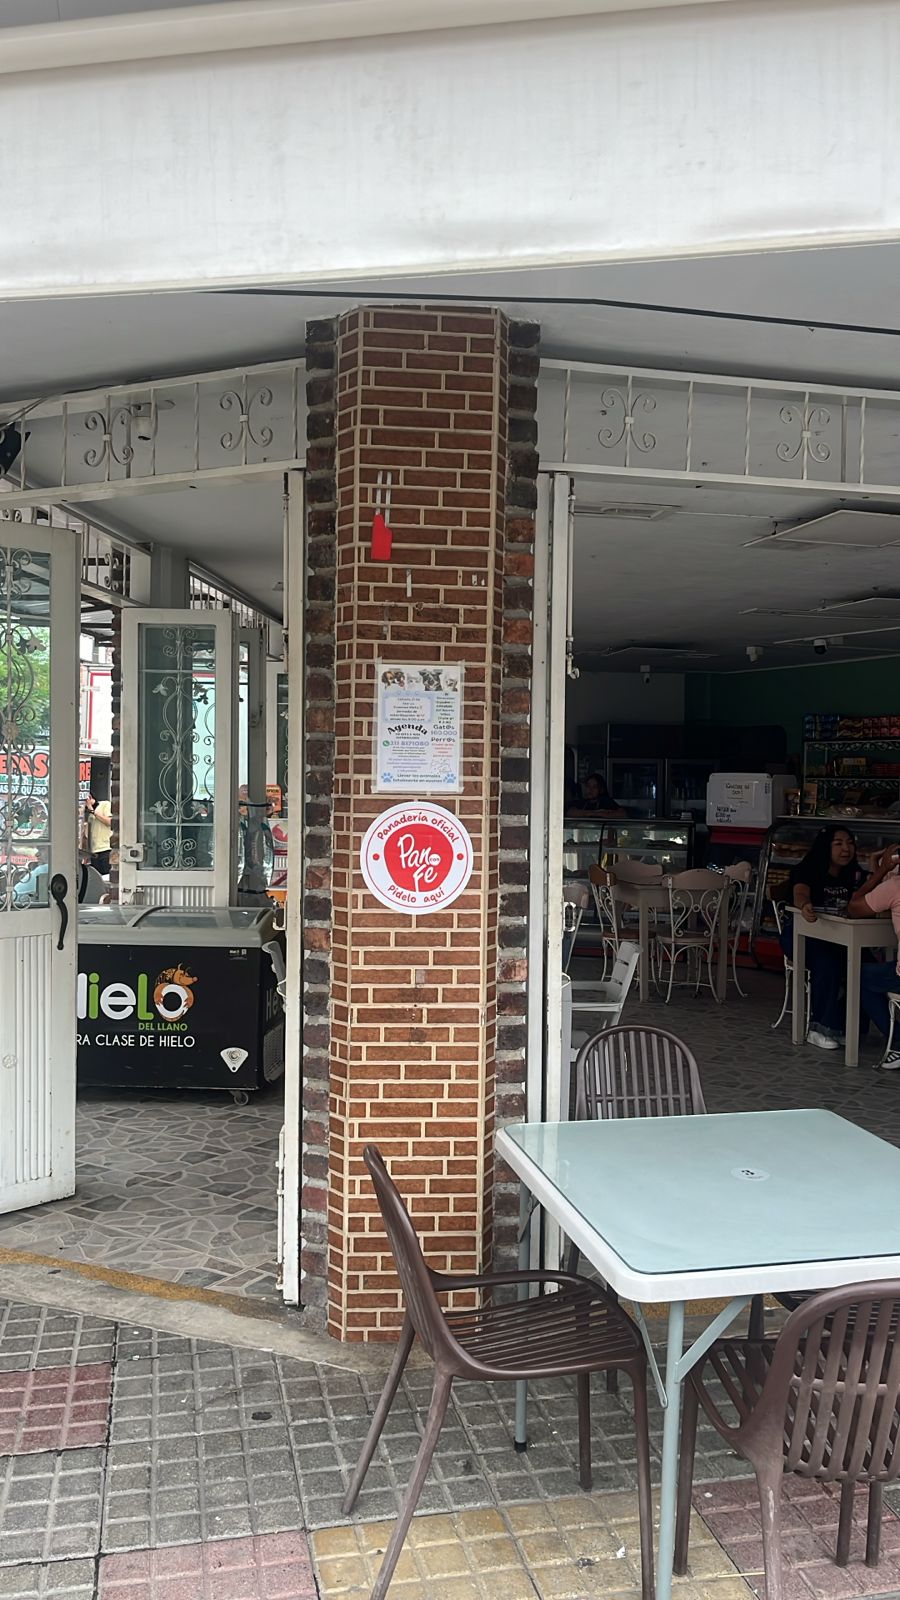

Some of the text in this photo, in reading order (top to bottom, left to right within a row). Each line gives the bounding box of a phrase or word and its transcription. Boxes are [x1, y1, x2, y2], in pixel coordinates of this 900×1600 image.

[387, 724, 428, 735] Agenda
[21, 786, 48, 796] QUESO
[377, 812, 459, 843] Panadería oficial
[397, 833, 432, 869] Pan
[412, 863, 438, 892] Fe
[138, 1022, 188, 1032] DEL LLANO
[95, 1034, 135, 1047] CLASE
[139, 1035, 154, 1047] DE
[159, 1035, 195, 1048] HIELO
